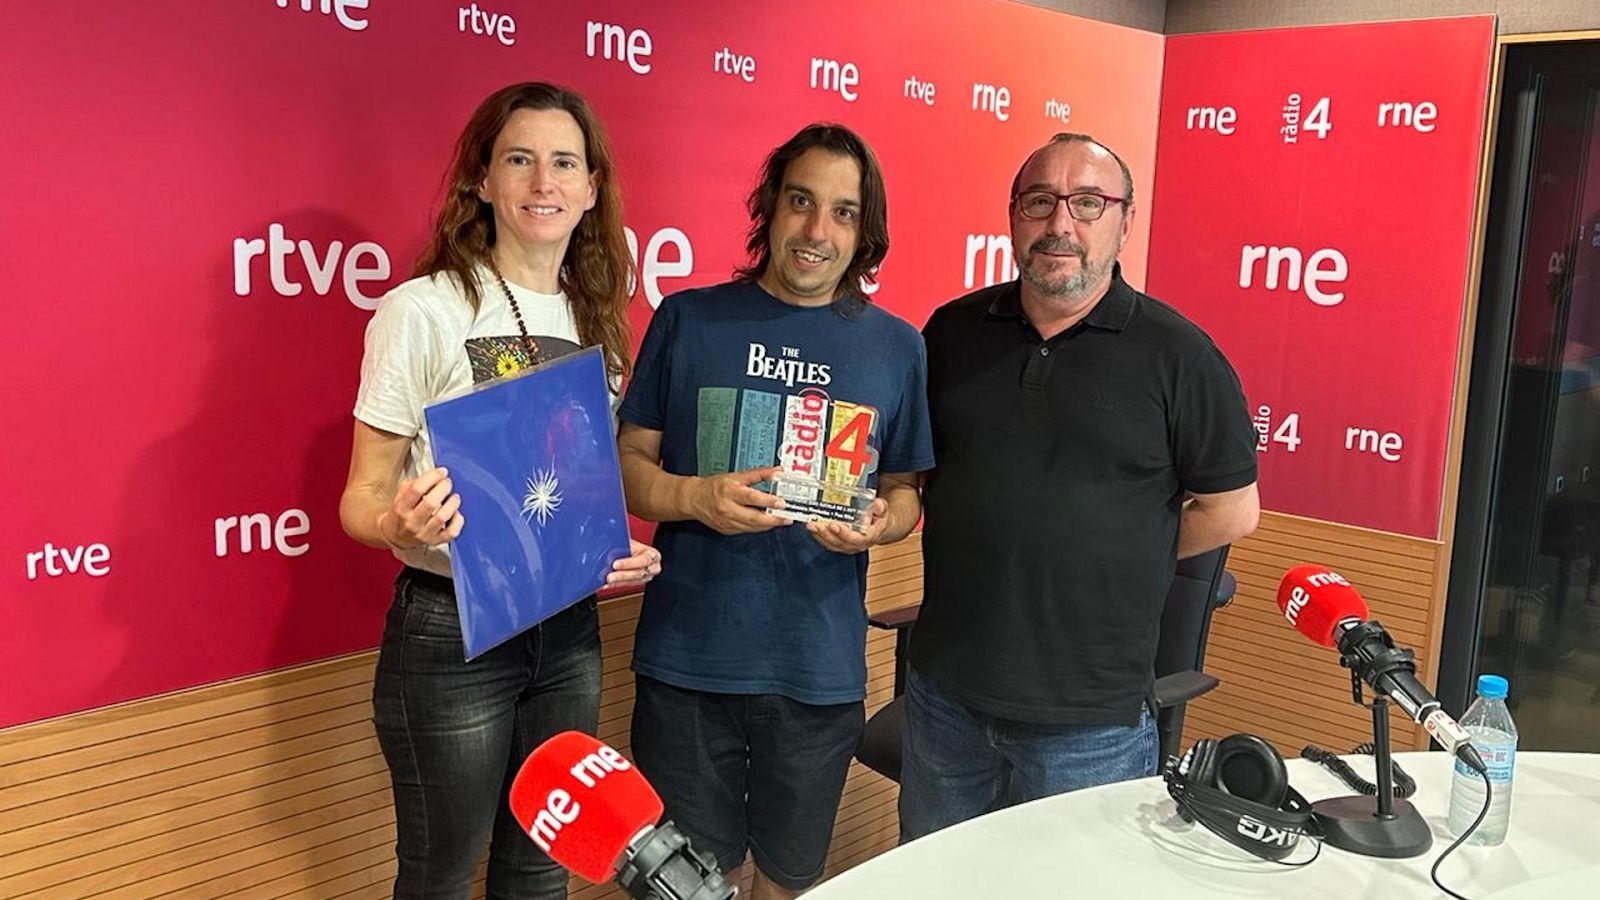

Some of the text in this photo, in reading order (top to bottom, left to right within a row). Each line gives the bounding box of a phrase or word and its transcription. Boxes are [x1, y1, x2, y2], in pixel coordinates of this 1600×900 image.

[459, 4, 516, 45] rtve
[586, 21, 652, 74] rne
[714, 47, 756, 82] rtve
[810, 57, 859, 101] rne
[904, 76, 936, 106] rtve
[972, 83, 1011, 121] rne
[1045, 98, 1071, 124] rtve
[1187, 106, 1237, 135] rne
[1280, 93, 1332, 144] ràdio 4
[1378, 101, 1438, 132] rne
[233, 223, 391, 311] rtve
[964, 233, 1020, 289] rn
[1239, 245, 1348, 306] rne
[746, 343, 832, 387] BEATLES
[781, 346, 800, 358] THE
[785, 394, 824, 474] ràdio
[825, 412, 873, 476] 4
[1273, 413, 1301, 452] 4
[1345, 427, 1403, 461] rne
[214, 508, 310, 557] rne
[26, 542, 110, 579] rtve
[1306, 571, 1351, 588] rne
[1285, 586, 1311, 626] rne
[569, 744, 631, 788] rne
[529, 788, 581, 851] rne
